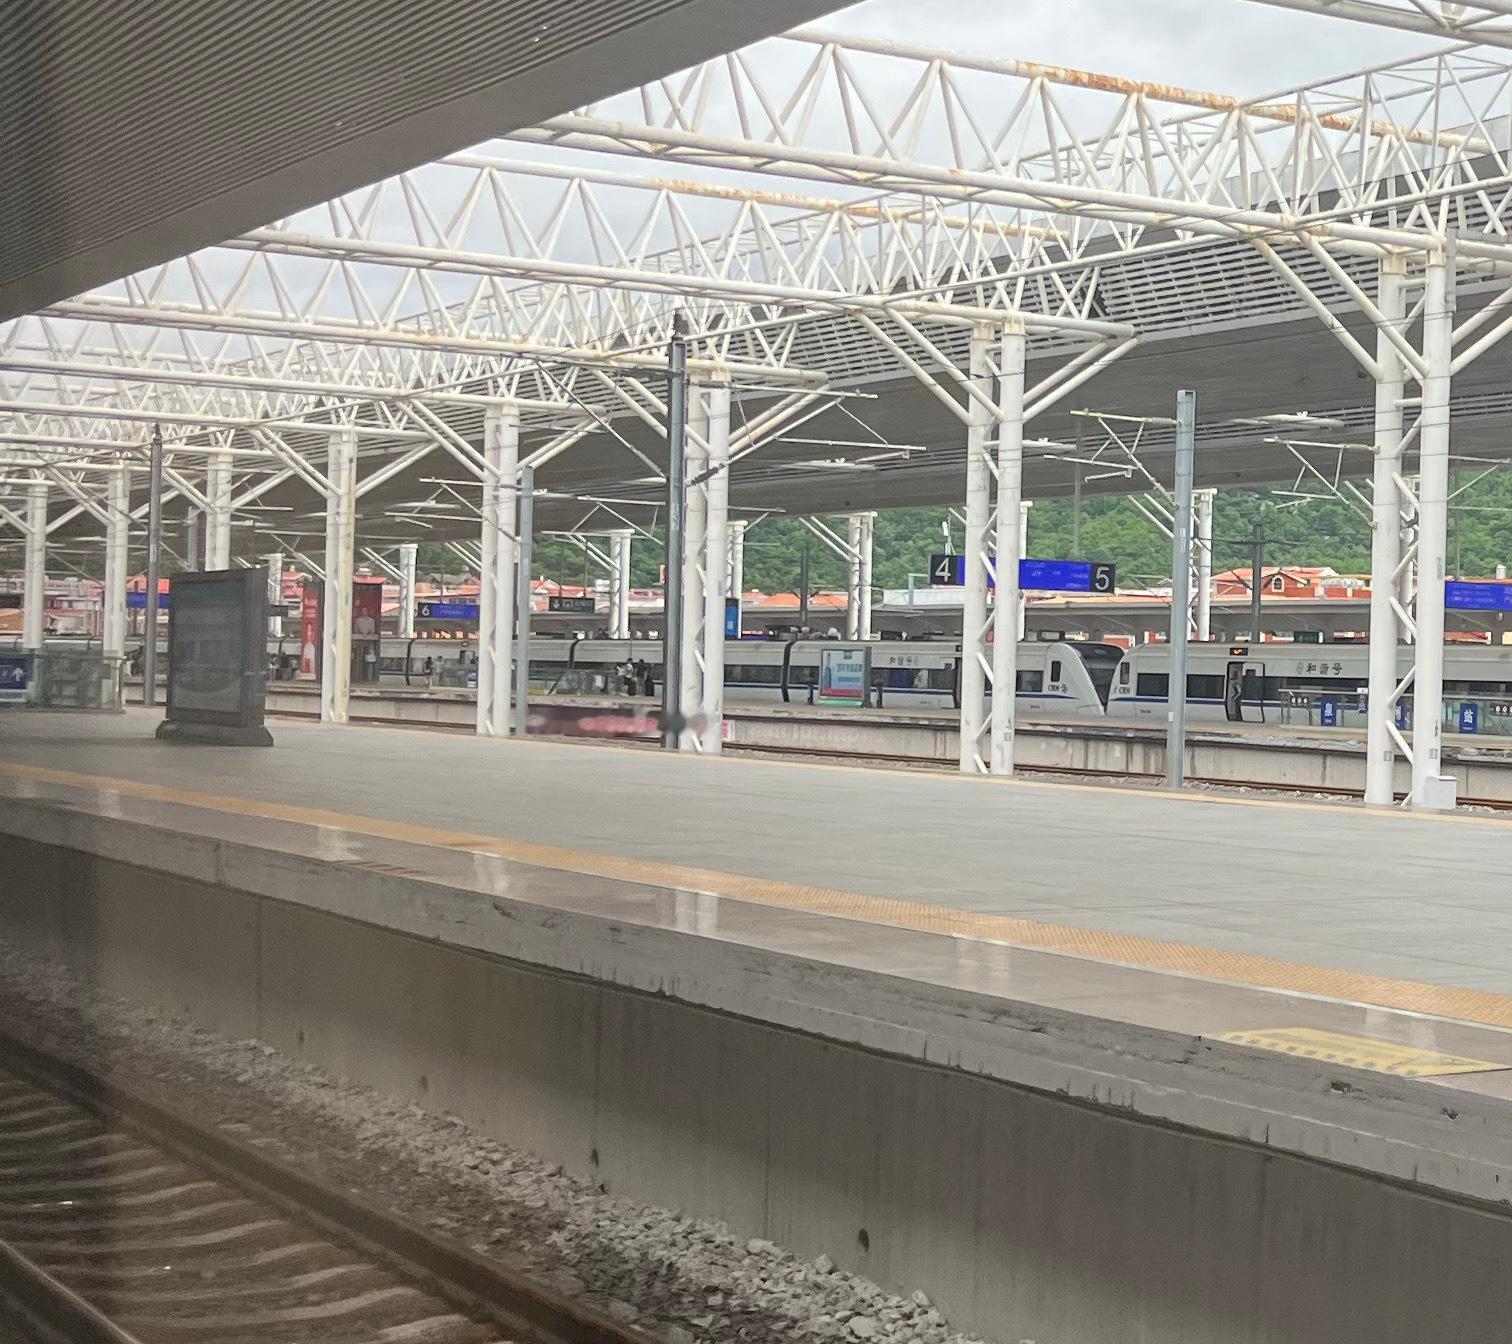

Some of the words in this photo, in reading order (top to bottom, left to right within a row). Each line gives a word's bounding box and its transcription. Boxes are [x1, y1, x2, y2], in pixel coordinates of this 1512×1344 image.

[935, 557, 951, 583] 4
[1095, 566, 1110, 591] 5
[422, 605, 430, 616] 6
[1306, 663, 1342, 675] 和谐号
[1463, 709, 1473, 723] 站
